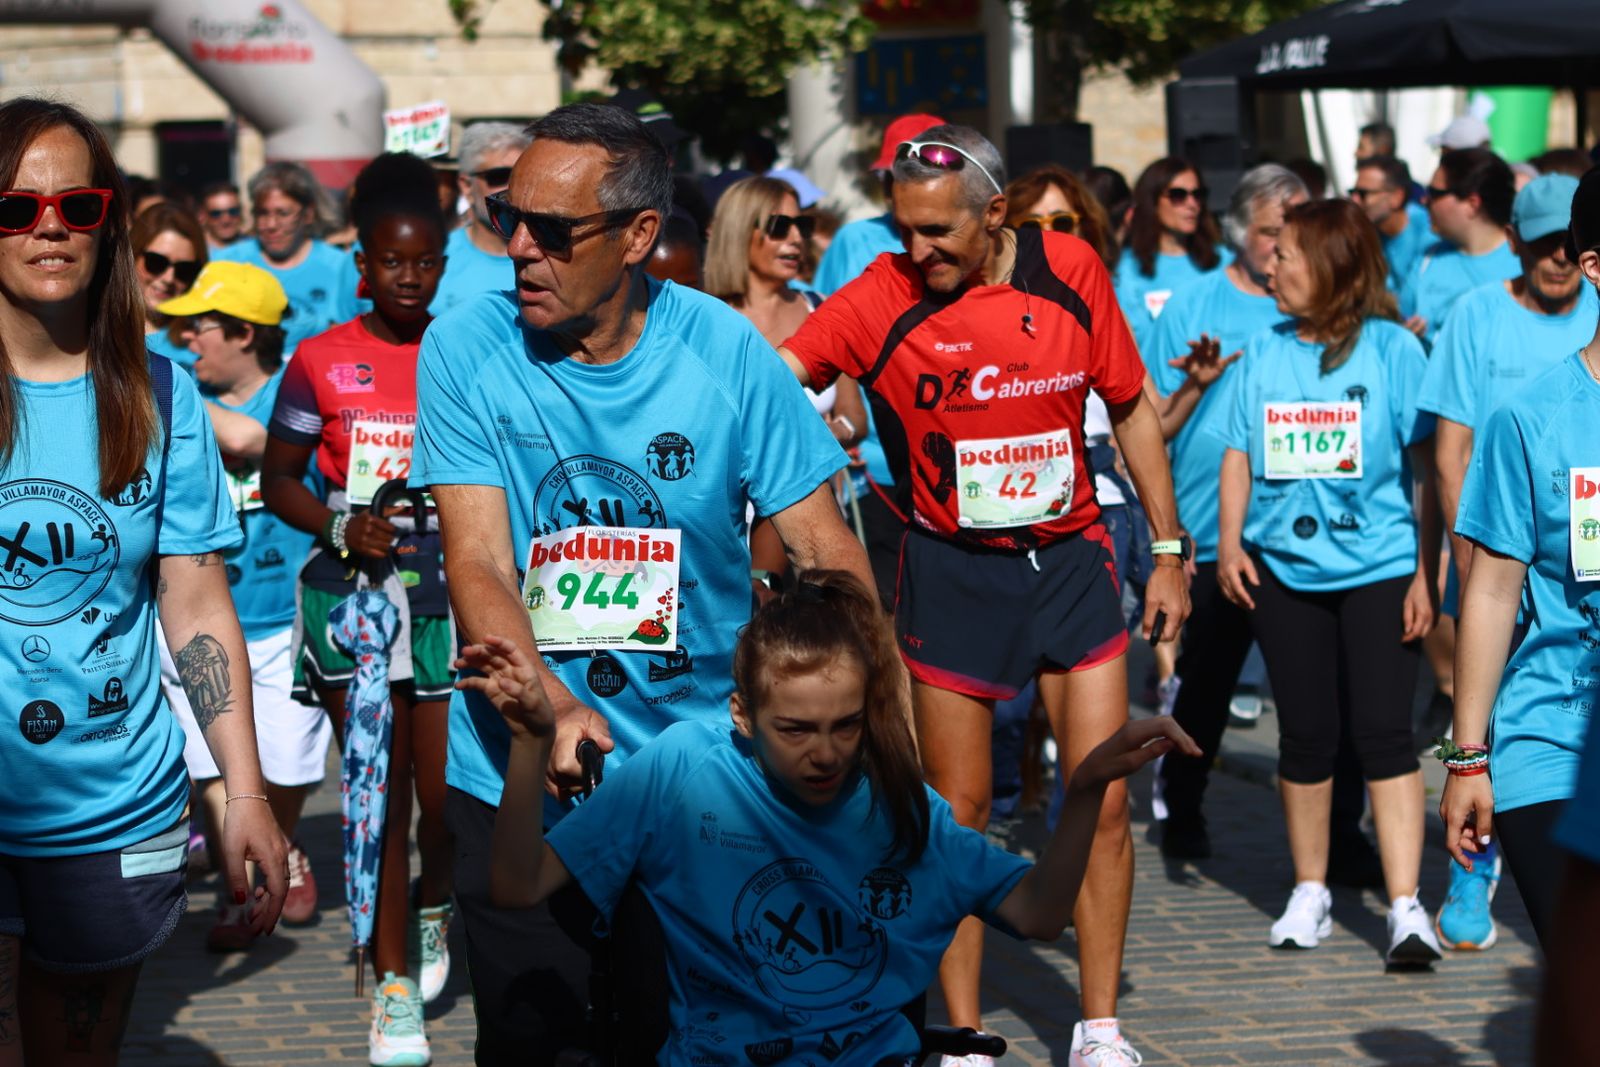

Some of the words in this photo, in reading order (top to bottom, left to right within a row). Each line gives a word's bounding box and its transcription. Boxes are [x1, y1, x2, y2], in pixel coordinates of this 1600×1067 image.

[1006, 362, 1030, 373] Club
[943, 403, 989, 414] Atletismo
[1267, 407, 1357, 425] bedunia
[652, 434, 685, 444] ASPACE
[1285, 430, 1346, 453] 1167
[566, 461, 615, 478] VILLAMAYOR
[616, 472, 648, 500] ASPACE
[998, 471, 1037, 500] 42
[1, 485, 67, 501] VILLAMAYOR
[67, 494, 102, 525] ASPACE
[529, 531, 675, 570] bedunia
[556, 572, 640, 611] 944
[592, 674, 622, 688] FISAN
[26, 719, 58, 734] FISAN
